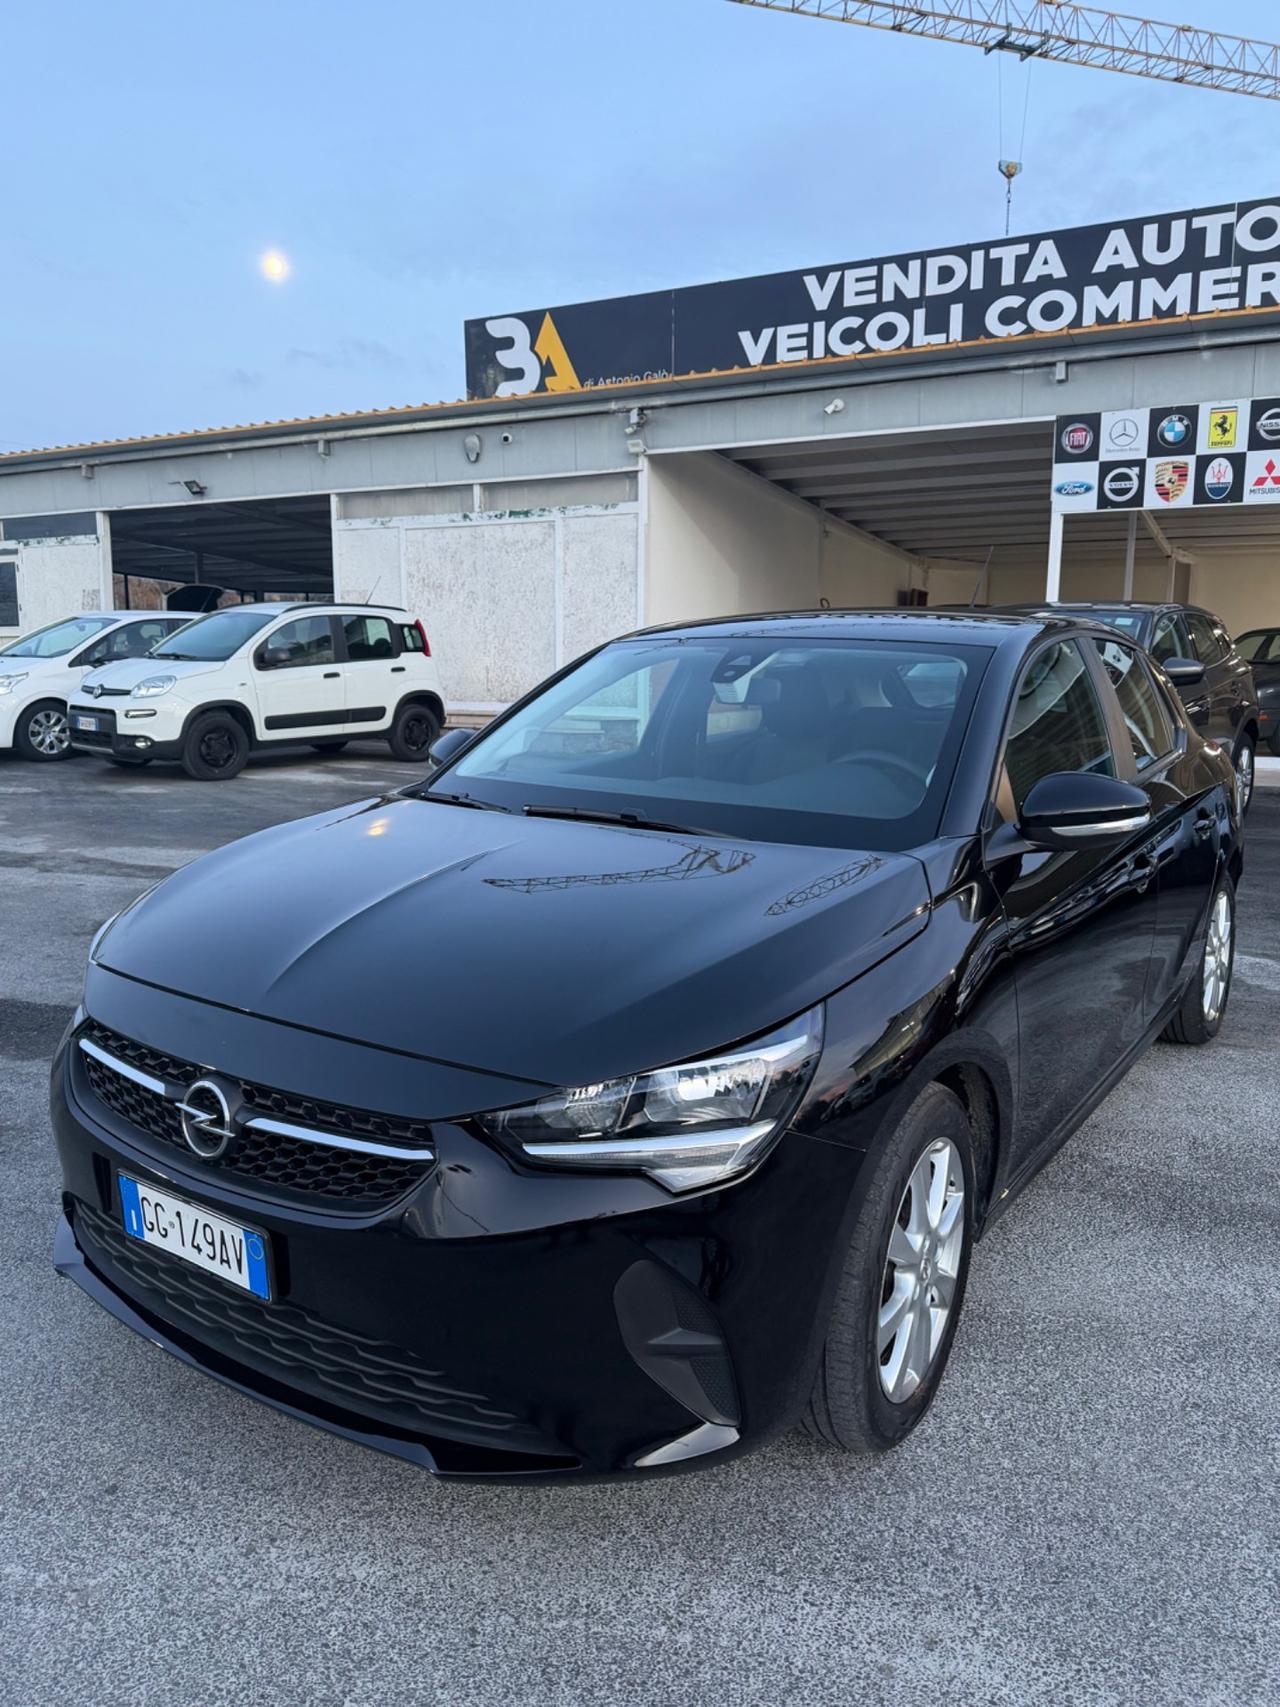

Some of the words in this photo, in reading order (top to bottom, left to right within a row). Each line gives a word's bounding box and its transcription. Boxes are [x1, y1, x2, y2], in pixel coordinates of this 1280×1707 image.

[802, 239, 1068, 311] VENDITA
[1091, 205, 1280, 274] AUTO
[737, 303, 964, 367] VEICOLI
[985, 261, 1280, 338] COMMER
[1069, 431, 1087, 447] FIAT
